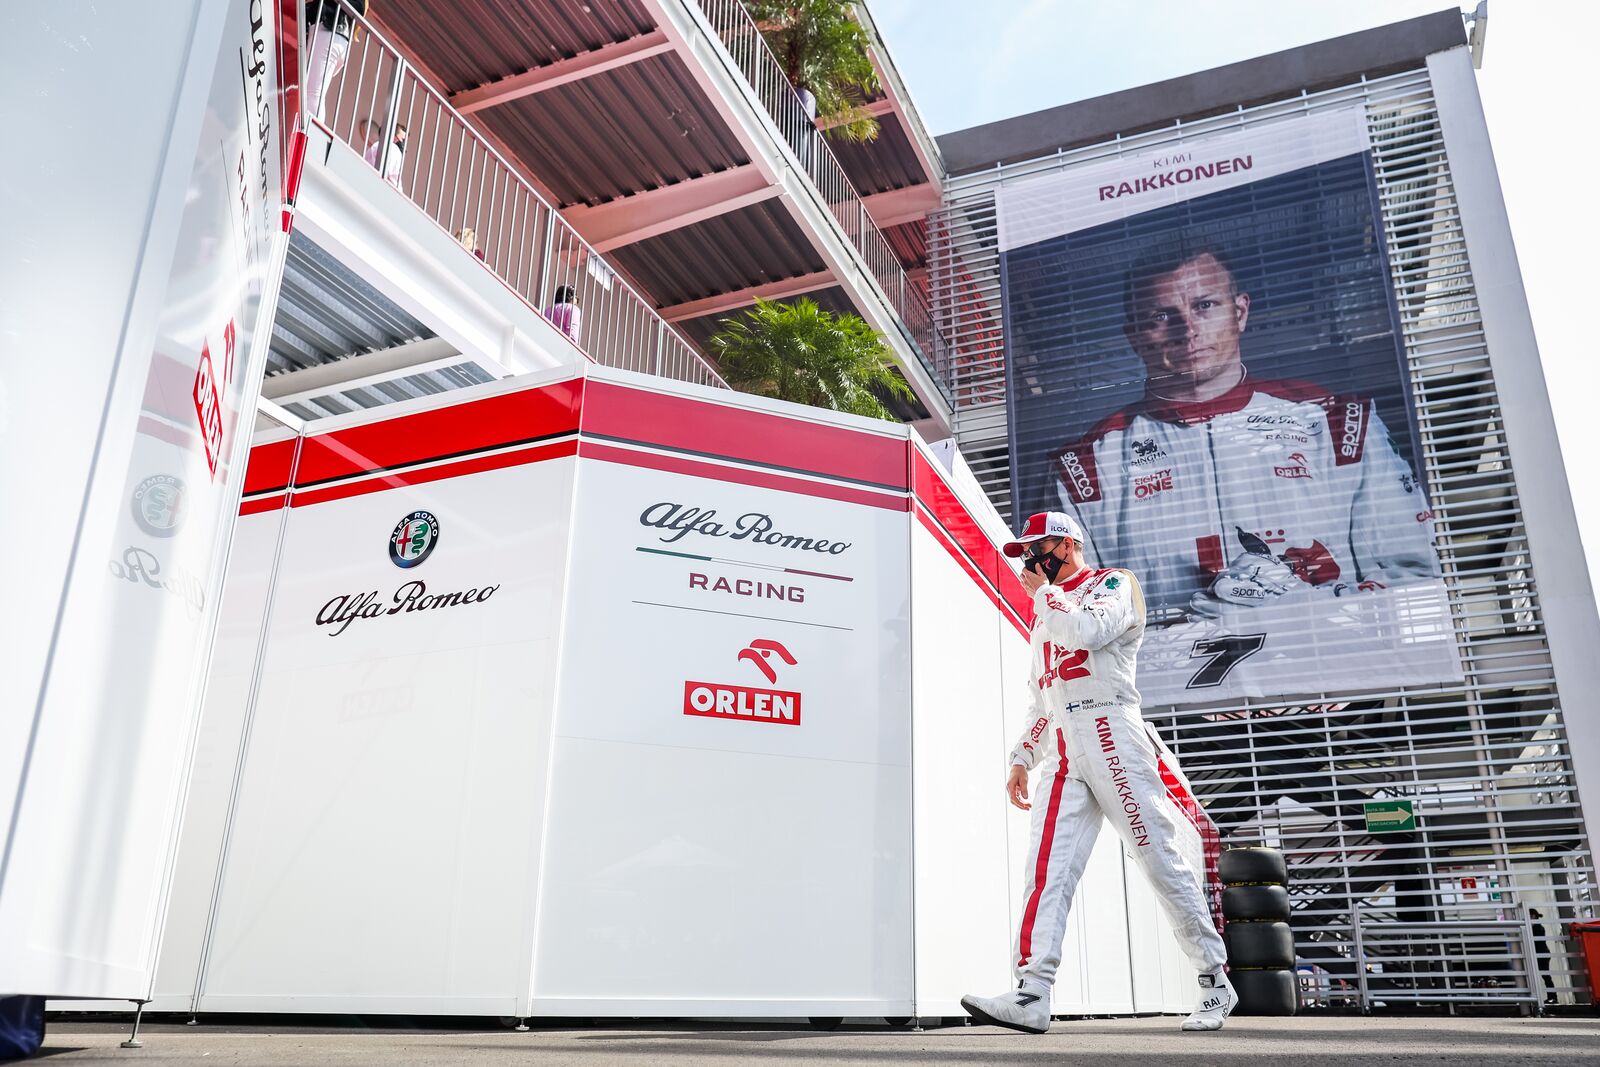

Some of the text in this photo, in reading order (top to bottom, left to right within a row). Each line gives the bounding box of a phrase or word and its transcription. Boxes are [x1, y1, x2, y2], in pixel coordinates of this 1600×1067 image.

[1153, 152, 1192, 168] KIMI
[1098, 155, 1253, 201] RAIKKONEN
[1341, 402, 1360, 458] sparco
[1060, 451, 1095, 498] sparco
[1131, 450, 1168, 467] SINGHA
[1134, 468, 1172, 486] EIGHTY
[1134, 476, 1174, 499] ONE
[391, 512, 438, 543] ALFA ROMEO
[639, 502, 853, 555] Alfa Romeo
[688, 572, 805, 603] RACING
[315, 579, 501, 637] Alfa Romeo
[1185, 632, 1268, 690] 7
[690, 686, 795, 721] ORLEN
[1095, 716, 1151, 848] KIMI RÄIKKÖNEN
[1202, 996, 1221, 1010] RAI
